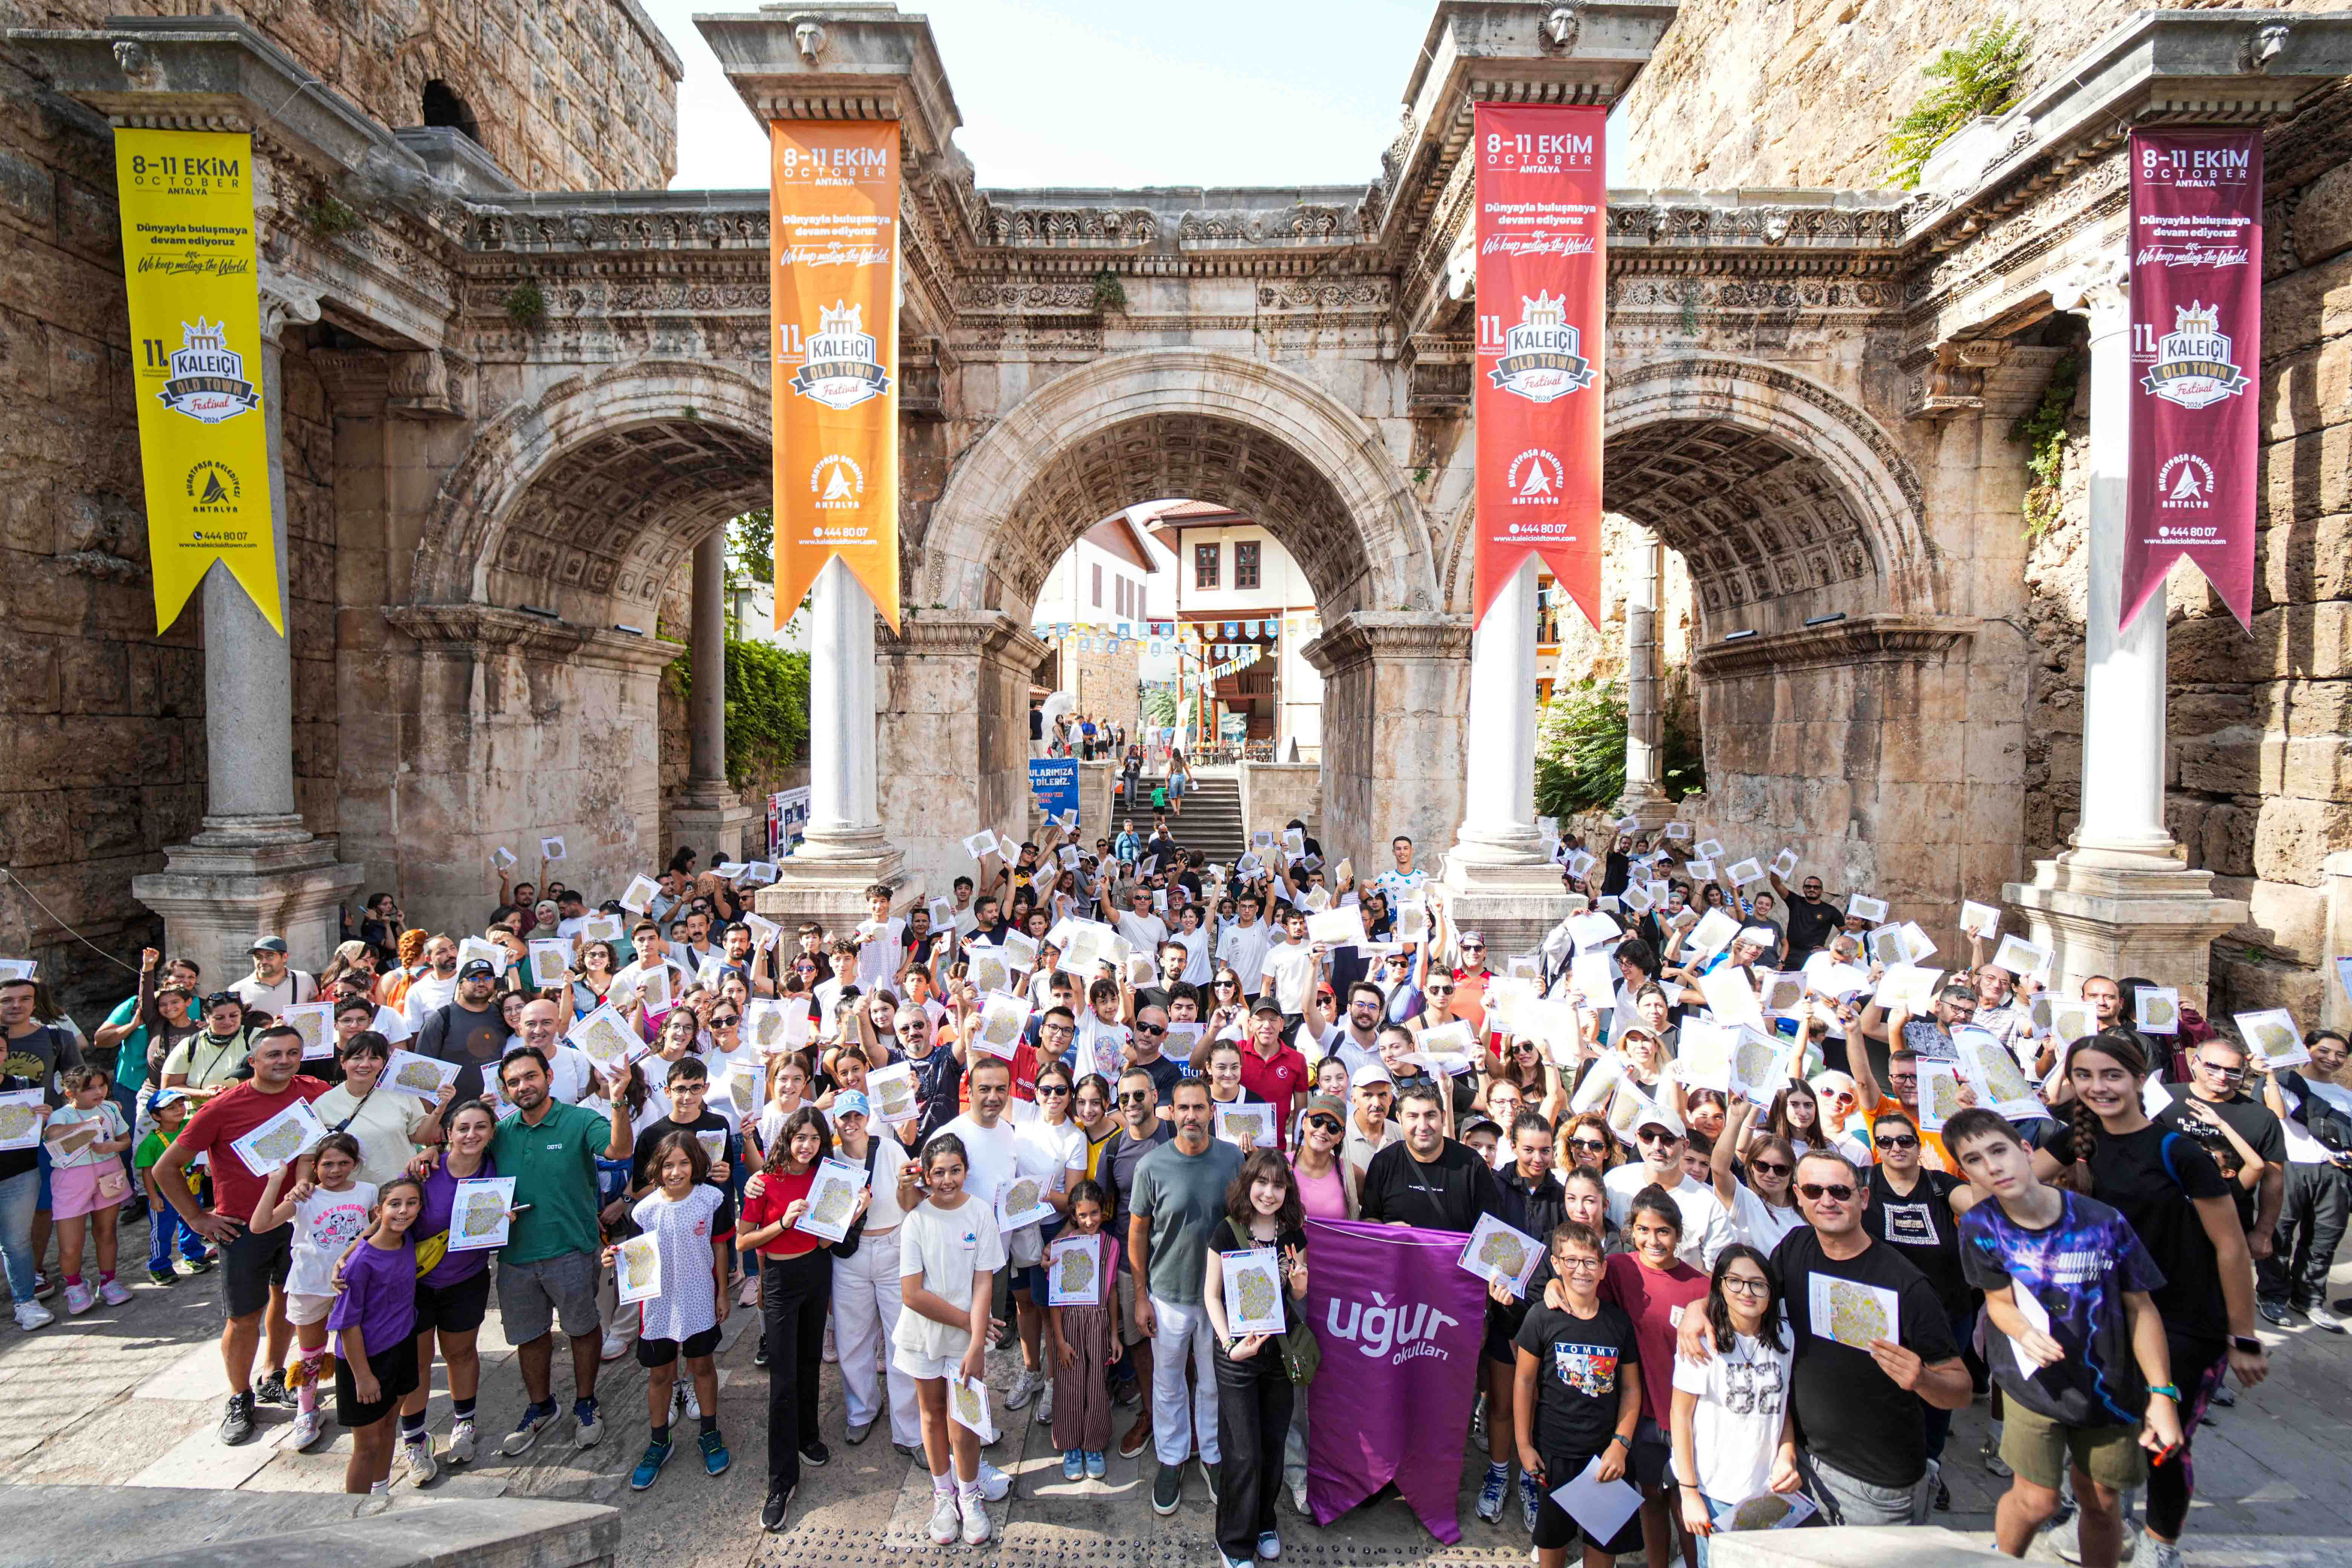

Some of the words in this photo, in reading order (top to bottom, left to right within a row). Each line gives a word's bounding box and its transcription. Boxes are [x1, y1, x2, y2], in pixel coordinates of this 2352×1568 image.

[1487, 134, 1531, 153] 8-11
[1538, 133, 1592, 153] EKİM
[784, 148, 826, 166] 8-11
[1488, 155, 1591, 164] OCTOBER
[2142, 149, 2187, 168] 8-11
[2194, 149, 2249, 168] EKİM
[132, 155, 176, 175] 8-11
[184, 158, 239, 176] EKİM
[784, 167, 885, 177] OCTOBER
[135, 176, 239, 187] OCTOBER
[815, 178, 854, 186] ANTALYA
[2144, 170, 2246, 179] OCTOBER
[1485, 203, 1535, 214] Dünyayla
[1538, 203, 1596, 214] buluşmaya
[783, 214, 830, 226] Dünyayla
[833, 214, 890, 226] buluşmaya
[1498, 215, 1534, 224] devam
[1536, 216, 1583, 226] ediyoruz
[2140, 216, 2190, 227] Dünyayla
[2192, 216, 2250, 227] buluşmaya
[137, 224, 186, 234] Dünyayla
[189, 224, 248, 236] buluşmaya
[795, 227, 830, 236] devam
[832, 227, 877, 238] ediyoruz
[2153, 228, 2188, 237] devam
[2190, 229, 2237, 238] ediyoruz
[151, 236, 186, 245] devam
[189, 237, 235, 247] ediyoruz
[1483, 237, 1500, 255] We
[1521, 240, 1551, 254] meeting
[1551, 239, 1564, 250] the
[1565, 238, 1592, 256] World
[138, 256, 154, 273] We
[175, 259, 204, 273] meeting
[206, 260, 217, 271] the
[219, 257, 247, 275] World
[2137, 250, 2154, 266] We
[2174, 253, 2204, 266] meeting
[2205, 250, 2217, 262] the
[2217, 249, 2246, 266] World
[1480, 315, 1504, 345] 11.
[2134, 324, 2158, 352] 11.
[1514, 330, 1572, 352] KALEİÇİ
[143, 339, 168, 366] 11.
[2168, 339, 2223, 362] KALEİÇİ
[178, 354, 236, 377] KALEİÇİ
[810, 363, 833, 377] OLD
[836, 363, 874, 377] TOWN
[1510, 356, 1535, 372] OLD
[1539, 356, 1577, 372] TOWN
[2162, 363, 2189, 379] OLD
[2193, 363, 2228, 379] TOWN
[175, 378, 201, 394] OLD
[204, 378, 243, 394] TOWN
[1521, 372, 1563, 389] Festival
[2174, 380, 2214, 396] Festival
[821, 381, 860, 398] Festival
[191, 396, 230, 412] Festival
[824, 527, 841, 537] 444
[1521, 524, 1539, 534] 444
[1541, 524, 1554, 534] 80
[1554, 524, 1567, 534] 07
[2170, 527, 2189, 537] 444
[2191, 527, 2203, 537] 80
[2204, 527, 2217, 537] 07
[1029, 768, 1073, 777] ULARIMIZA
[314, 1207, 334, 1225] BEST
[1326, 1291, 1459, 1358] uğur
[1392, 1341, 1449, 1366] okulları
[1559, 1344, 1615, 1357] TOMMY
